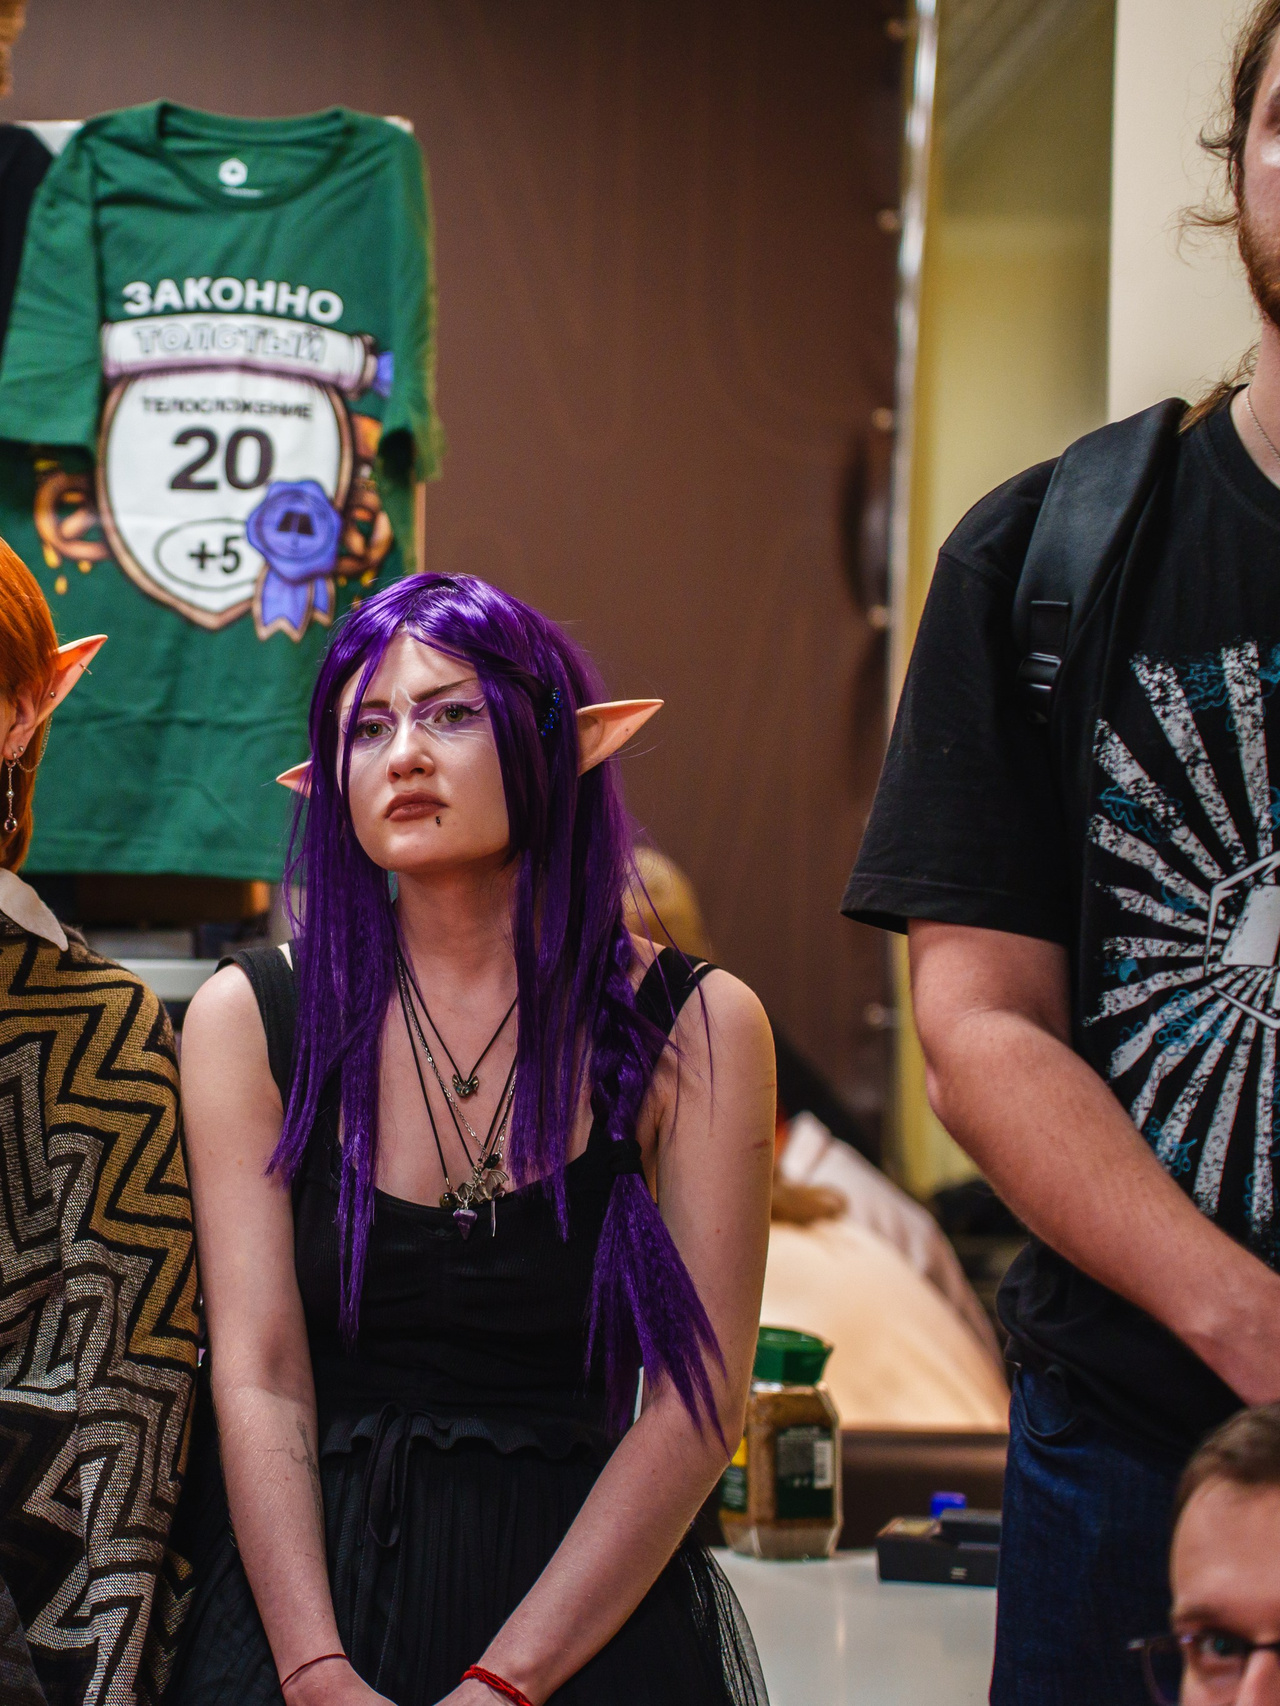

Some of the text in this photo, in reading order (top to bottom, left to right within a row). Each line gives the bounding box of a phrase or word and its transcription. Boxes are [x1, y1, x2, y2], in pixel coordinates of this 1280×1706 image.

[122, 277, 344, 323] ЗАКОННО
[170, 426, 275, 491] 20
[187, 534, 243, 575] +5
